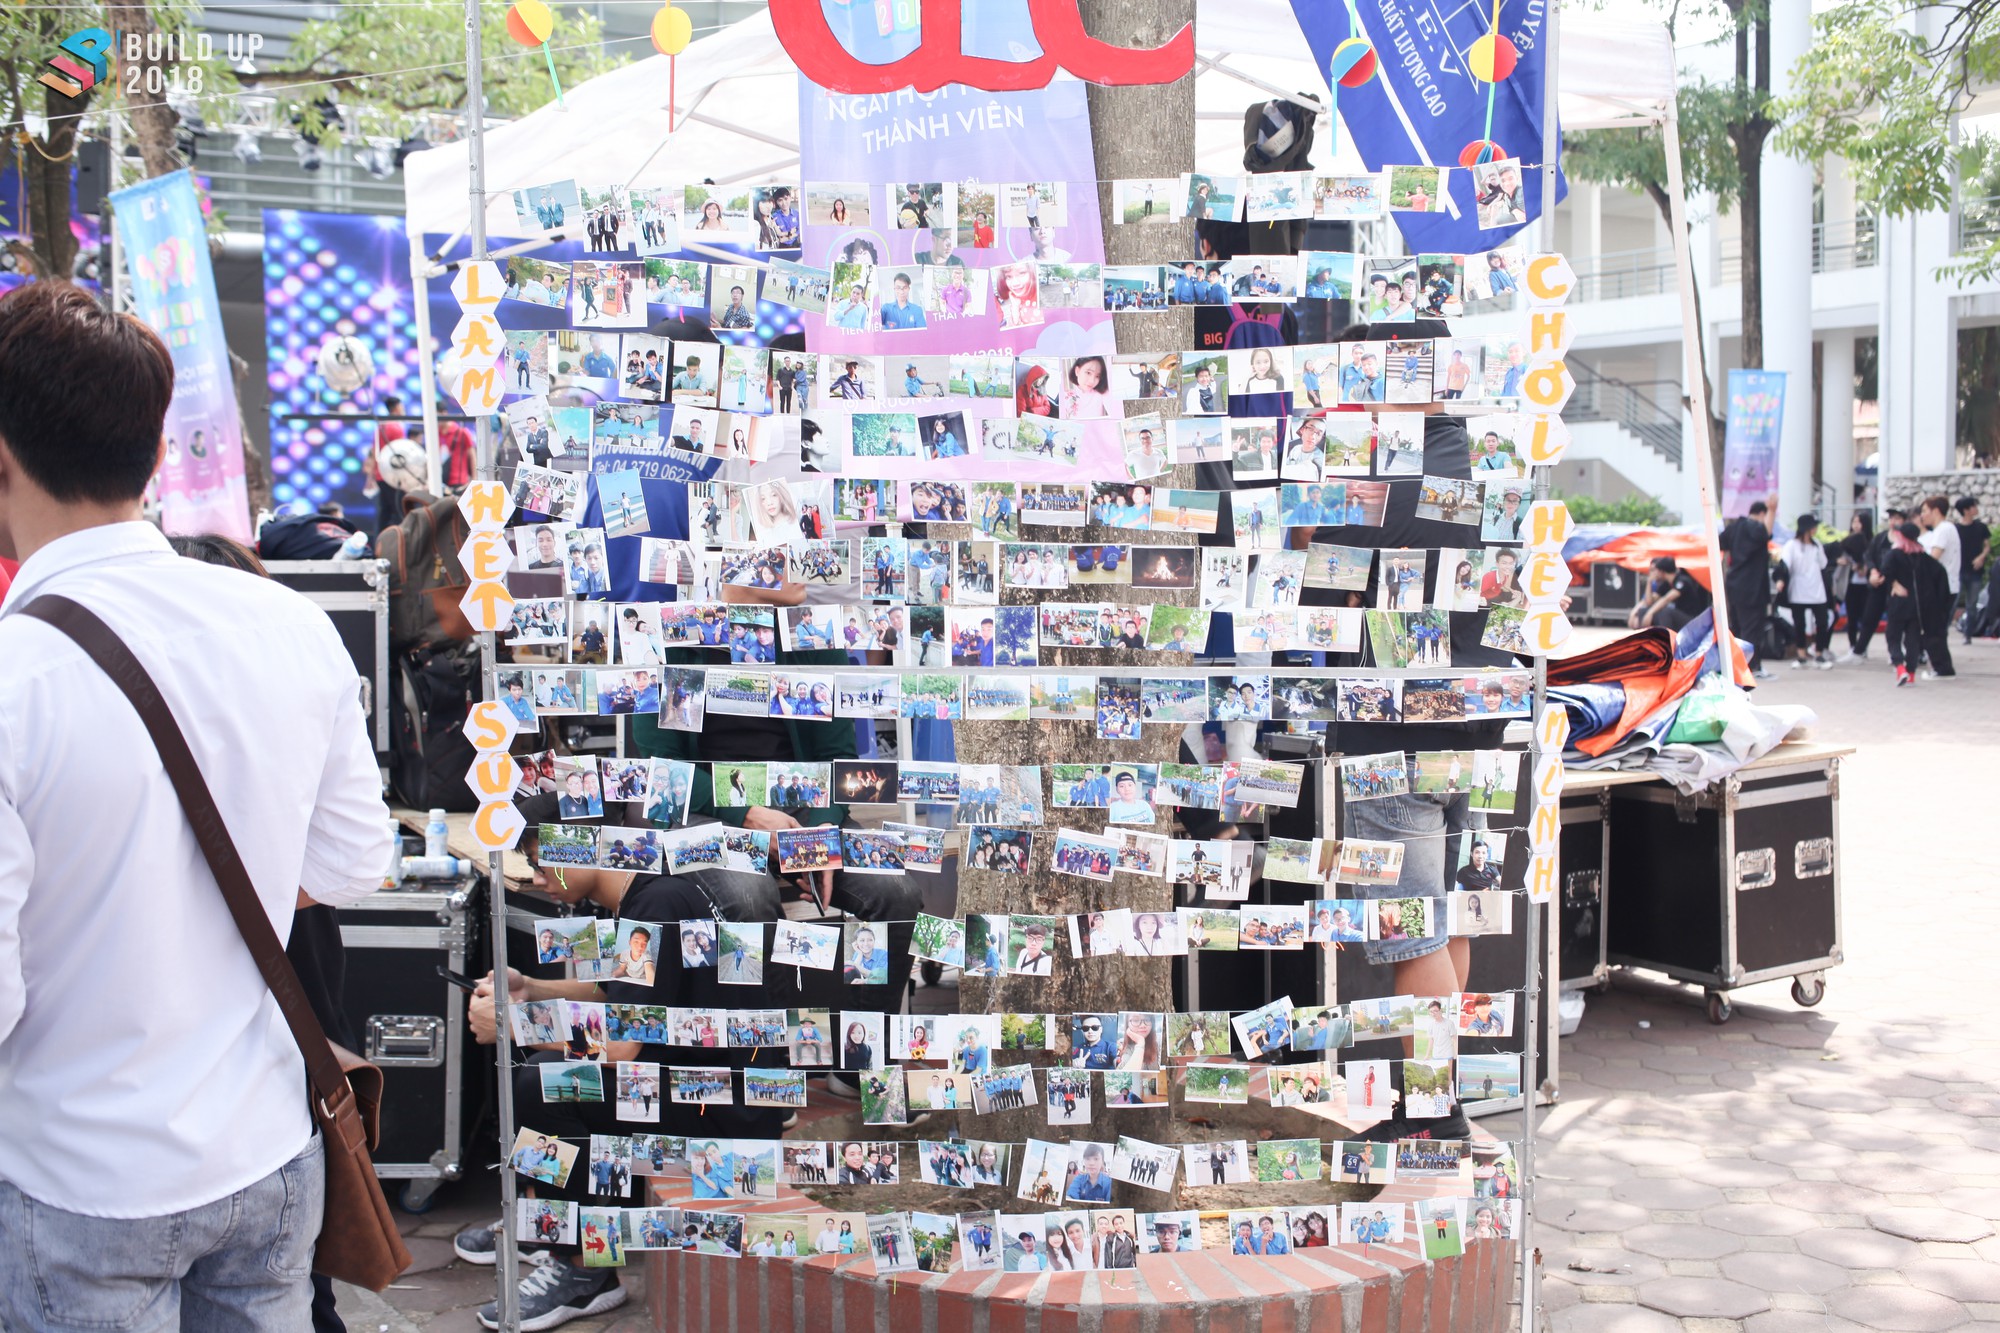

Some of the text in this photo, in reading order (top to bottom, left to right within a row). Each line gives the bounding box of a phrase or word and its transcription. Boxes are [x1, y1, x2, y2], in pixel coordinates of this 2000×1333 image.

[1393, 30, 1431, 89] LƯỢNG
[1421, 82, 1447, 117] CAO
[862, 99, 1025, 155] THÀNH VIÊN
[1203, 332, 1223, 346] BIG
[631, 460, 659, 478] 3719
[660, 464, 693, 485] 0627
[467, 483, 516, 630] HẾT
[1530, 505, 1568, 650] HẾT
